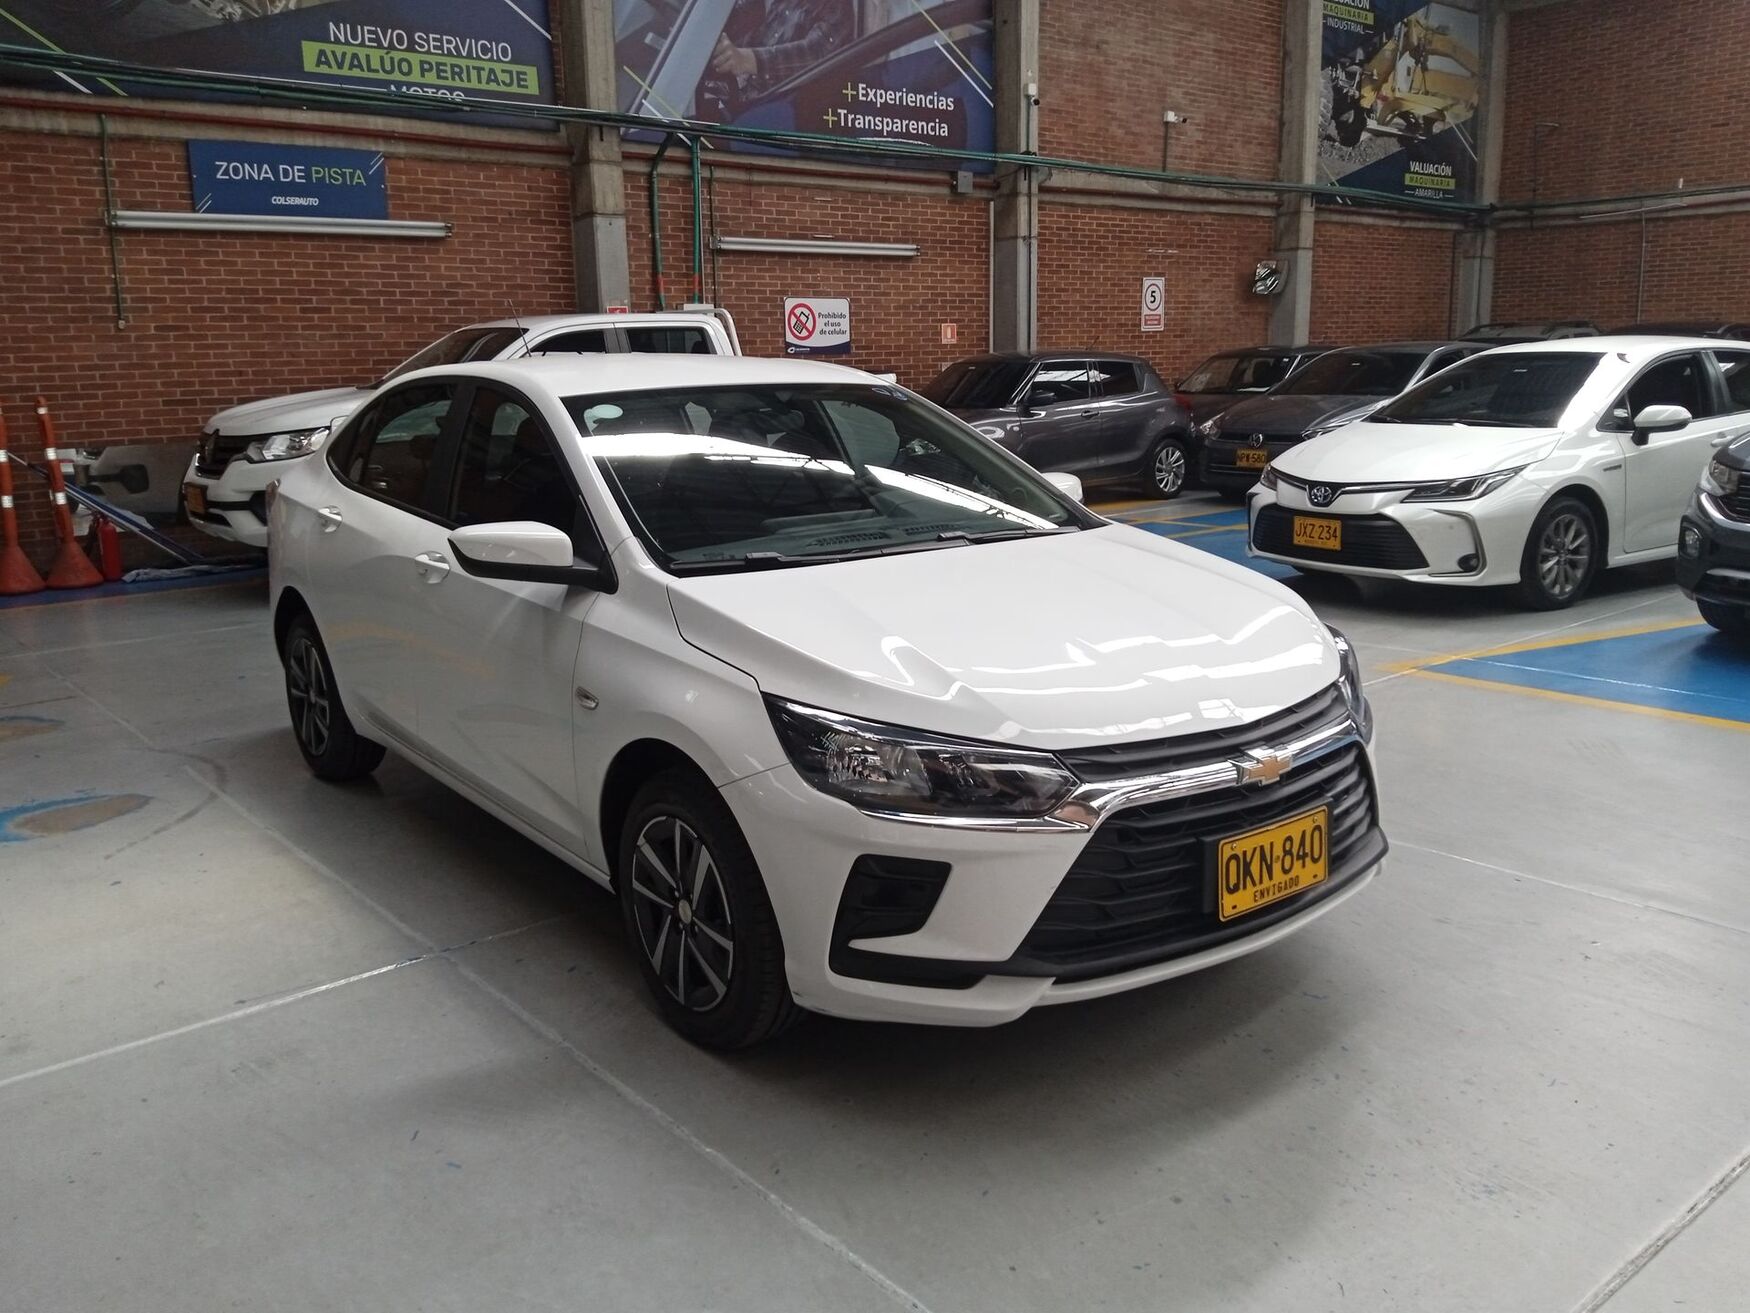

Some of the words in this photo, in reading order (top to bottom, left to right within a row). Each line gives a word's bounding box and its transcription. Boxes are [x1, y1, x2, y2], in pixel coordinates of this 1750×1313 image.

[1327, 17, 1365, 34] INDUSTRIAL
[329, 21, 407, 50] NUEVO
[414, 32, 512, 62] SERVICIO
[315, 49, 413, 77] AVALÚO
[419, 59, 529, 89] PERITAJE
[215, 161, 274, 181] ZONA
[279, 165, 306, 183] DE
[311, 166, 367, 187] PISTA
[1410, 160, 1452, 176] VALUACIÓN
[271, 195, 319, 206] COLSERAUTO
[1150, 290, 1156, 304] 5
[1253, 875, 1300, 902] ENVIGADO
